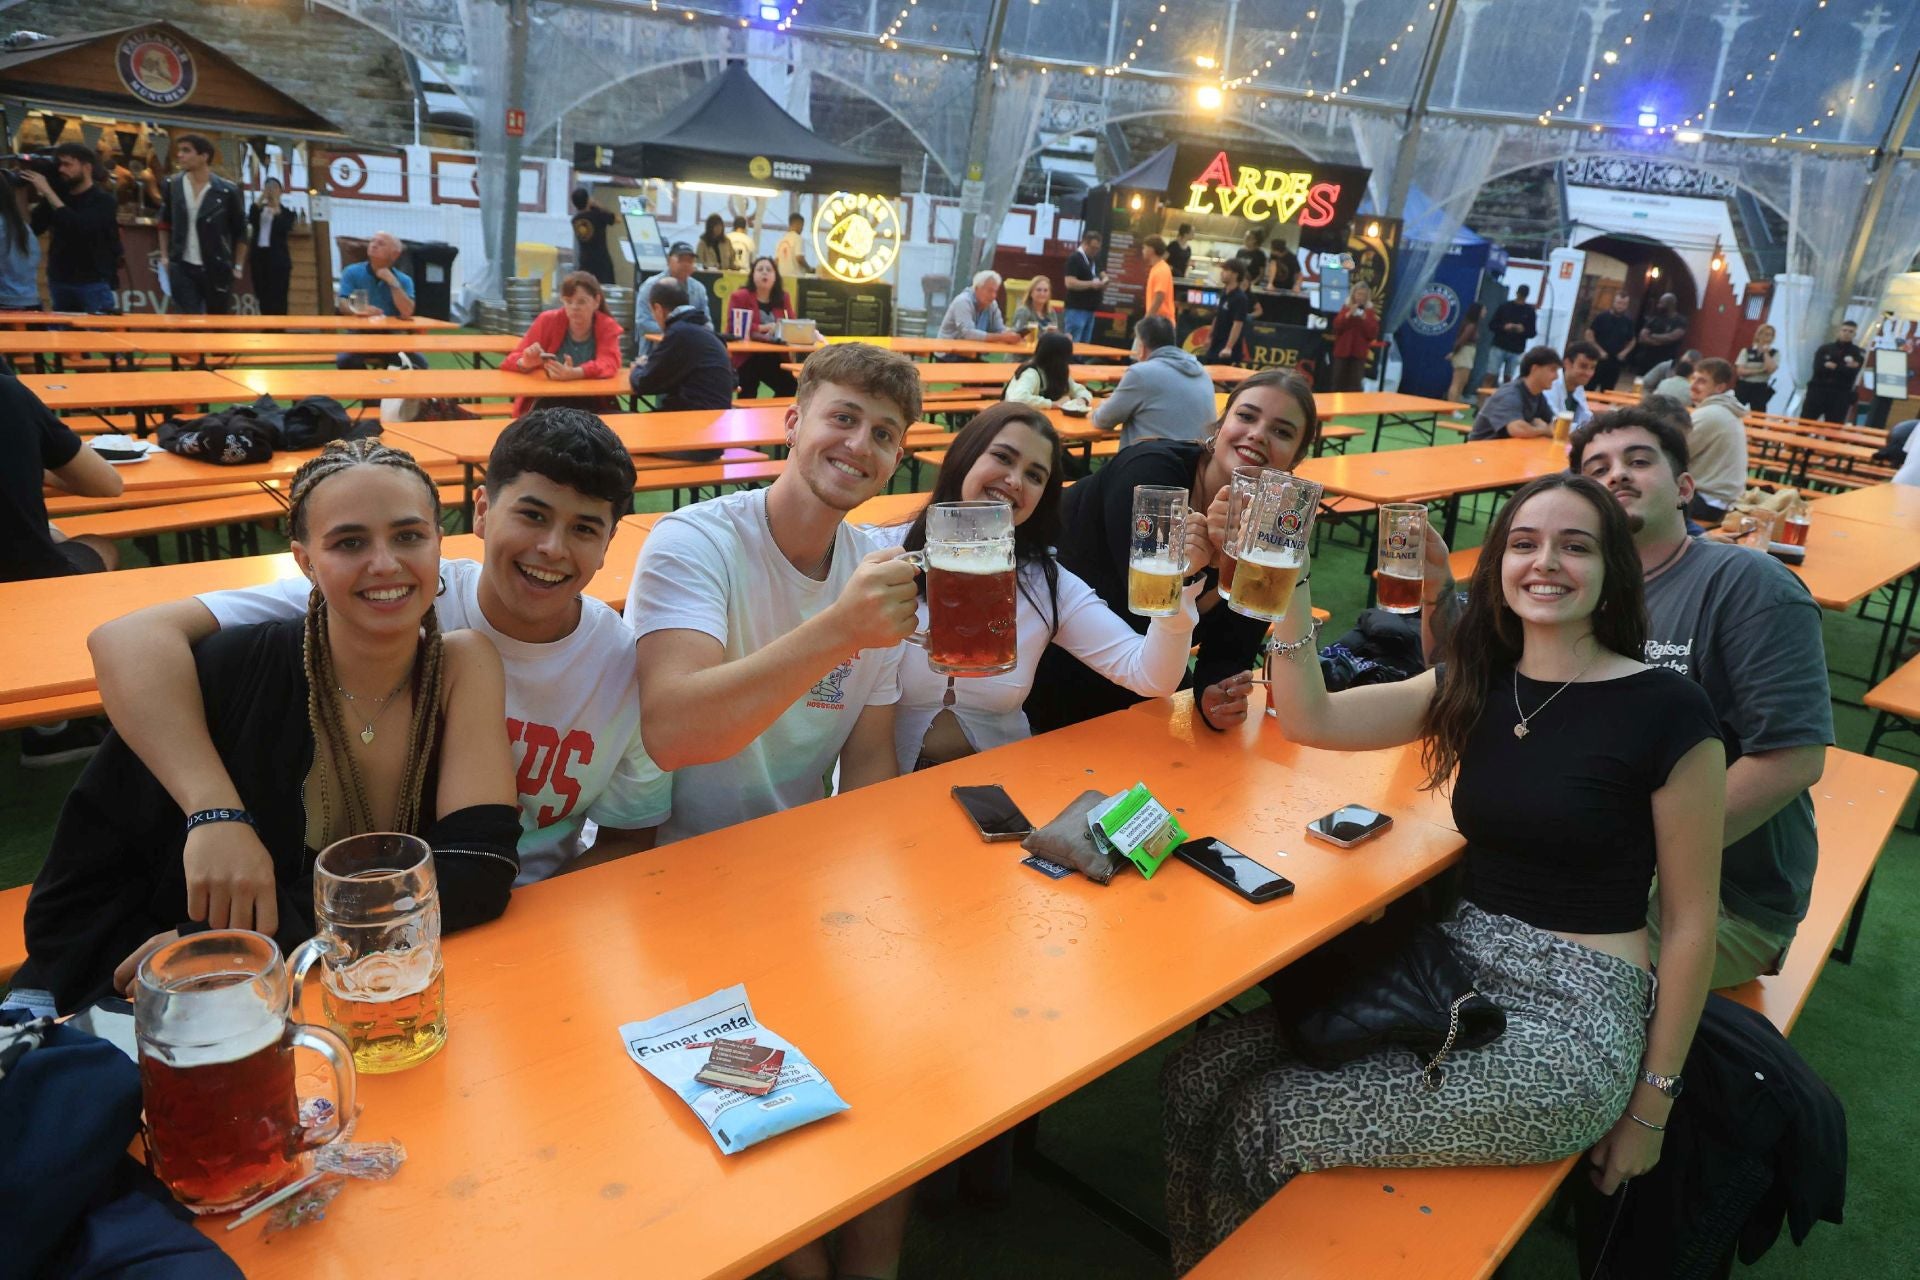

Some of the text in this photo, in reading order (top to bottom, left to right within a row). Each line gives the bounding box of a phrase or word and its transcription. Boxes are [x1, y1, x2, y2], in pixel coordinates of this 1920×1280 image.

[1192, 151, 1313, 198] ARDE
[823, 193, 889, 225] PROPER
[1184, 182, 1341, 227] LVCVS
[1257, 531, 1306, 551] PAULANER
[637, 1033, 698, 1057] Fumar
[703, 1016, 750, 1039] mata
